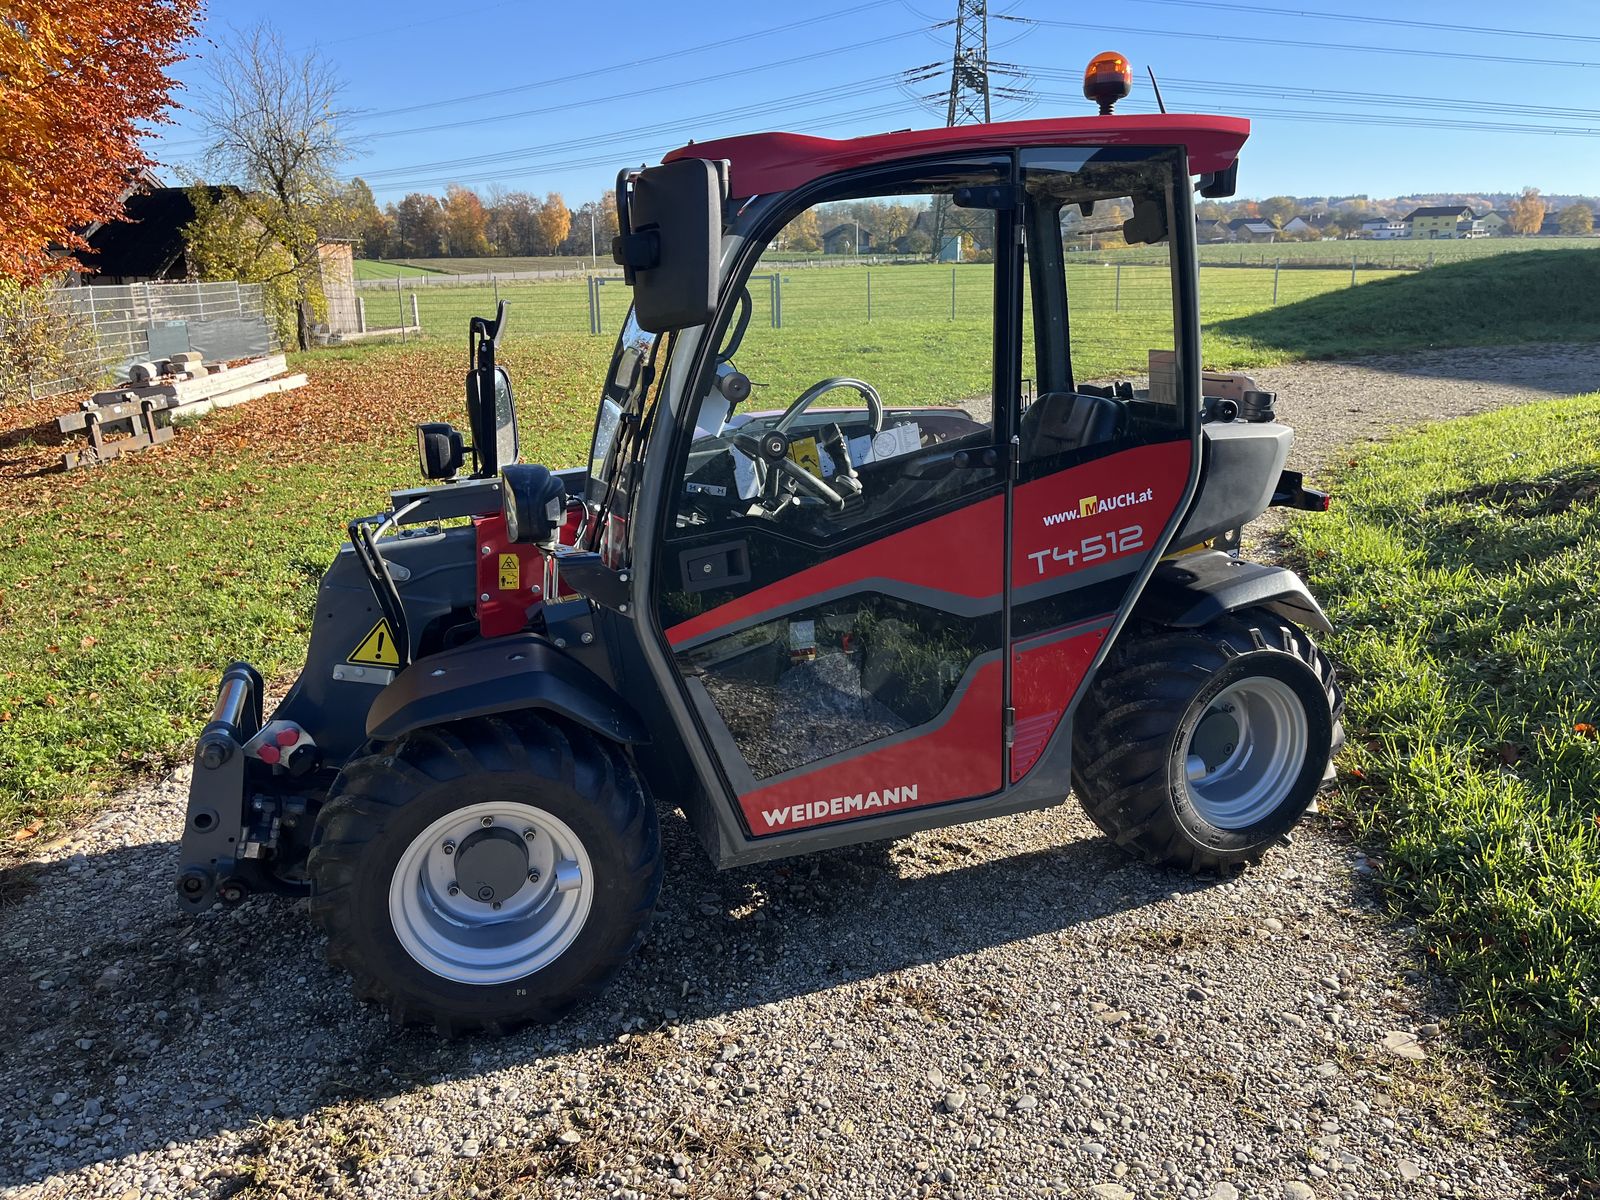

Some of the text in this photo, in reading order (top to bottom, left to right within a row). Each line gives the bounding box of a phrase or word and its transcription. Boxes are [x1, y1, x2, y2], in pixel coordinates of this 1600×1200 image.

[1043, 488, 1153, 526] www.MAUCH.at
[1028, 525, 1143, 574] T4512
[762, 784, 918, 827] WEIDEMANN
